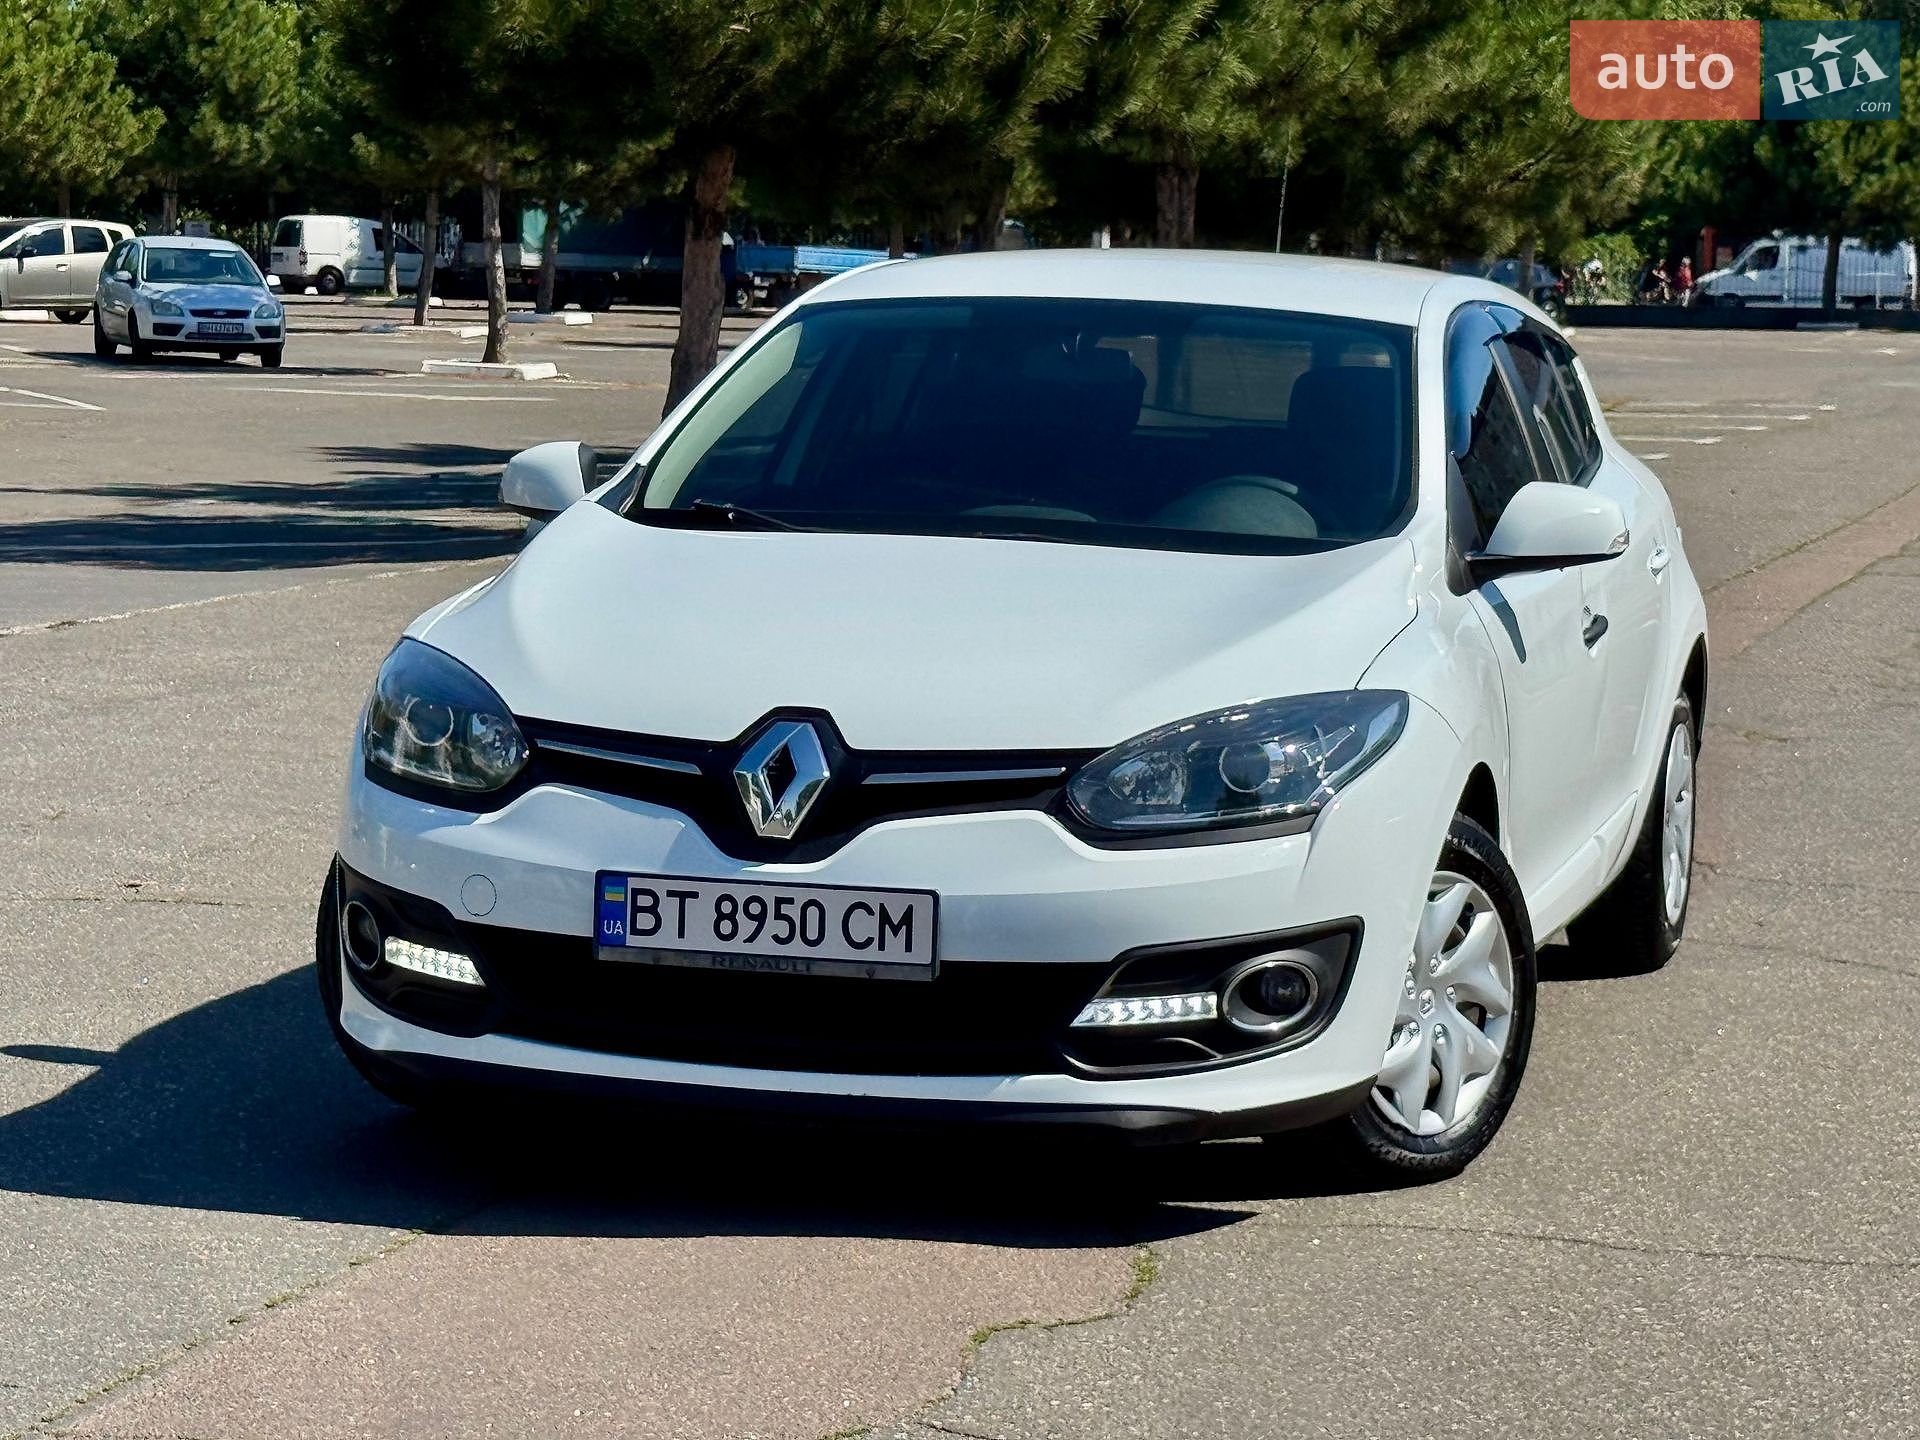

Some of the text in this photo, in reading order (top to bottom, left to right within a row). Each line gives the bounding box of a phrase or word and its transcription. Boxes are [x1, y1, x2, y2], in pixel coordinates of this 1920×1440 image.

[603, 918, 624, 935] UA
[629, 887, 914, 953] BT 8950 CM
[711, 955, 814, 974] RENAULT
